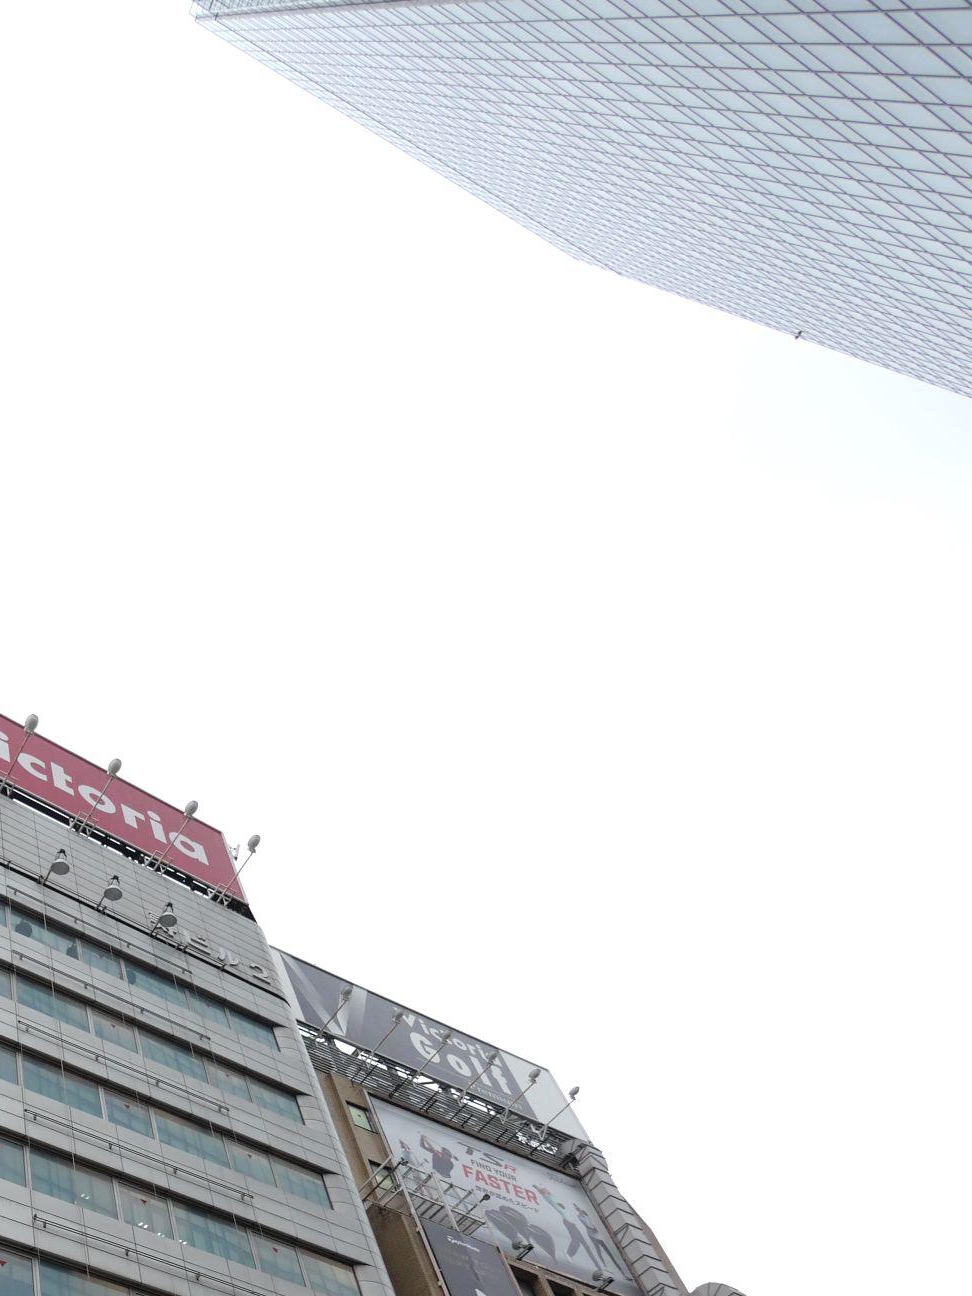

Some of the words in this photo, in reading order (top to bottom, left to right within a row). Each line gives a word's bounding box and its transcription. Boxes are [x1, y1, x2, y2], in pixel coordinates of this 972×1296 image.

[409, 1031, 512, 1096] Golf
[462, 1164, 540, 1206] FASTER
[471, 1159, 492, 1172] FIND
[493, 1168, 517, 1182] YOUR
